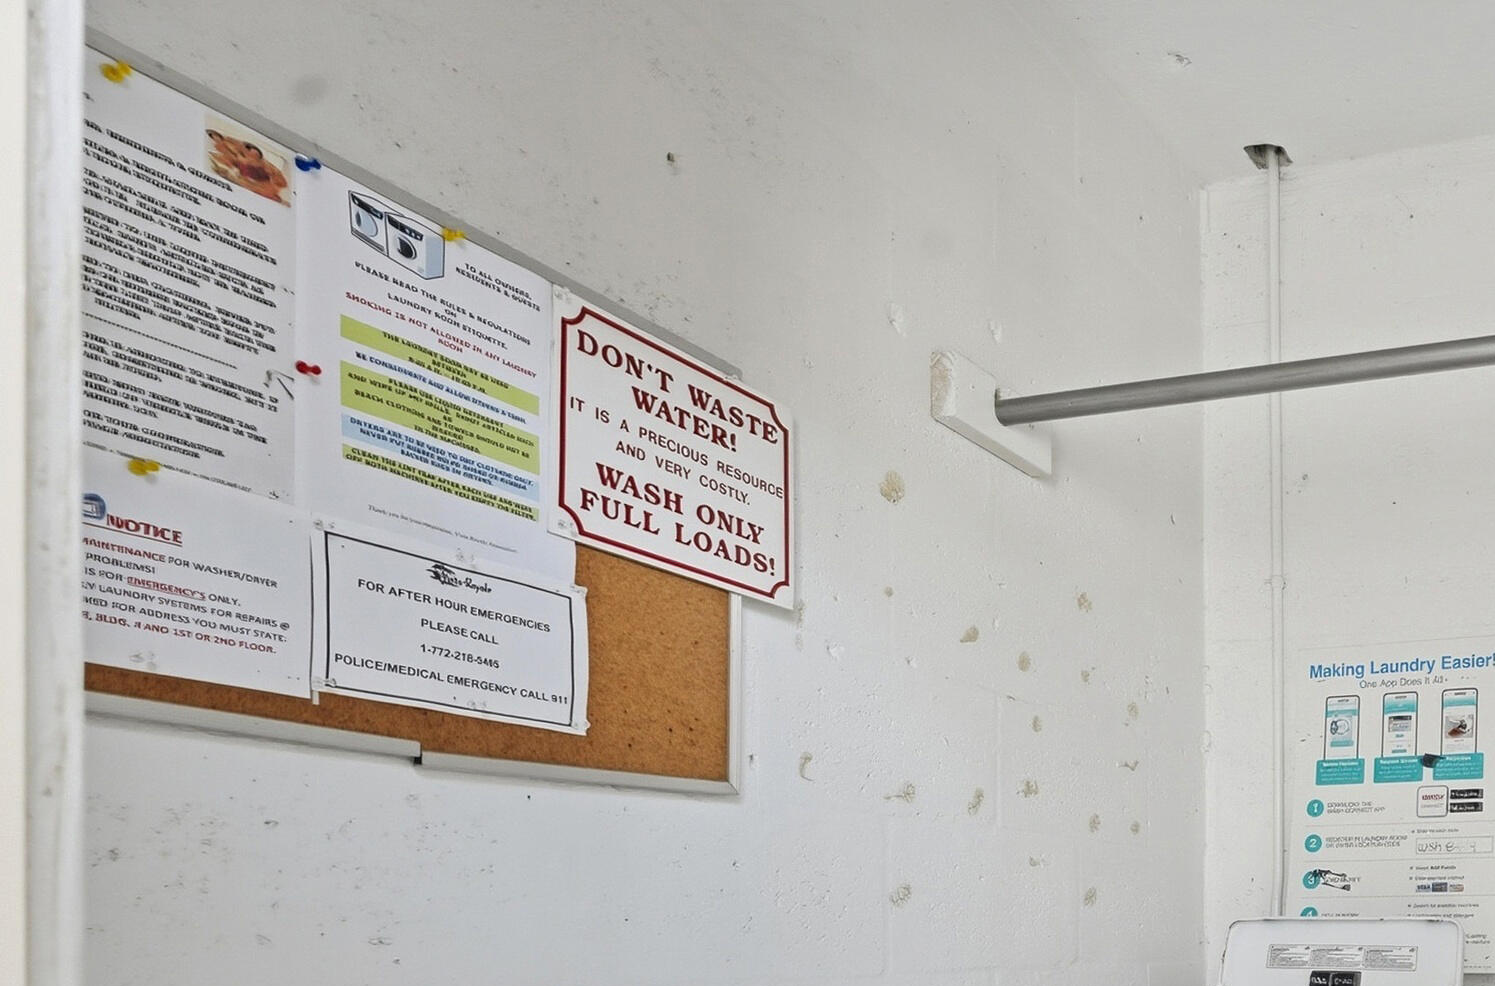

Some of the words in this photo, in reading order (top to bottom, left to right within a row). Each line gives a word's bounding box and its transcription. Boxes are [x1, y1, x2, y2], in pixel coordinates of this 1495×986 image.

[577, 329, 674, 393] DON'T
[688, 384, 778, 444] WASTE
[631, 386, 736, 452] WATER!
[570, 396, 585, 412] IT
[596, 407, 609, 423] IS
[620, 419, 629, 432] A
[639, 427, 708, 466] PRECIOUS
[717, 460, 783, 499] RESOURCE
[616, 441, 646, 461] AND
[655, 456, 691, 480] VERY
[699, 475, 750, 505] COSTLY.
[595, 462, 683, 515] WASH
[696, 504, 764, 544] ONLY
[107, 514, 182, 544] NOTICE
[580, 488, 660, 535] FULL
[675, 522, 775, 576] LOADS!
[85, 567, 96, 576] IS
[99, 570, 122, 581] FOR
[208, 594, 241, 606] ONLY.
[168, 556, 189, 568] FOR
[192, 562, 277, 588] WASHER/DRYER
[99, 585, 155, 602] LAUNDRY
[158, 597, 207, 613] SYSTEMS
[210, 608, 232, 618] FOR
[235, 613, 277, 627] REPAIRS
[112, 602, 136, 613] FOR
[139, 608, 190, 624] ADDRESS
[192, 618, 216, 629] YOU
[219, 624, 251, 635] MUST
[358, 578, 384, 594] FOR
[388, 587, 431, 604] AFTER
[435, 597, 468, 613] HOUR
[470, 606, 550, 632] EMERGENCIES
[95, 613, 130, 627] BLDG.
[144, 624, 169, 634] AND
[173, 628, 192, 638] 1ST
[195, 633, 211, 642] OR
[214, 636, 236, 646] 2ND
[239, 641, 276, 654] FLOOR.
[421, 618, 468, 638] PLEASE
[470, 630, 498, 645] CALL
[335, 653, 444, 682] POLICE/MEDICAL
[447, 675, 516, 695] EMERGENCY
[520, 689, 549, 701] CALL
[551, 694, 567, 704] 911
[1310, 662, 1365, 679] Making
[1371, 658, 1436, 674] Laundry
[1310, 838, 1317, 848] 2
